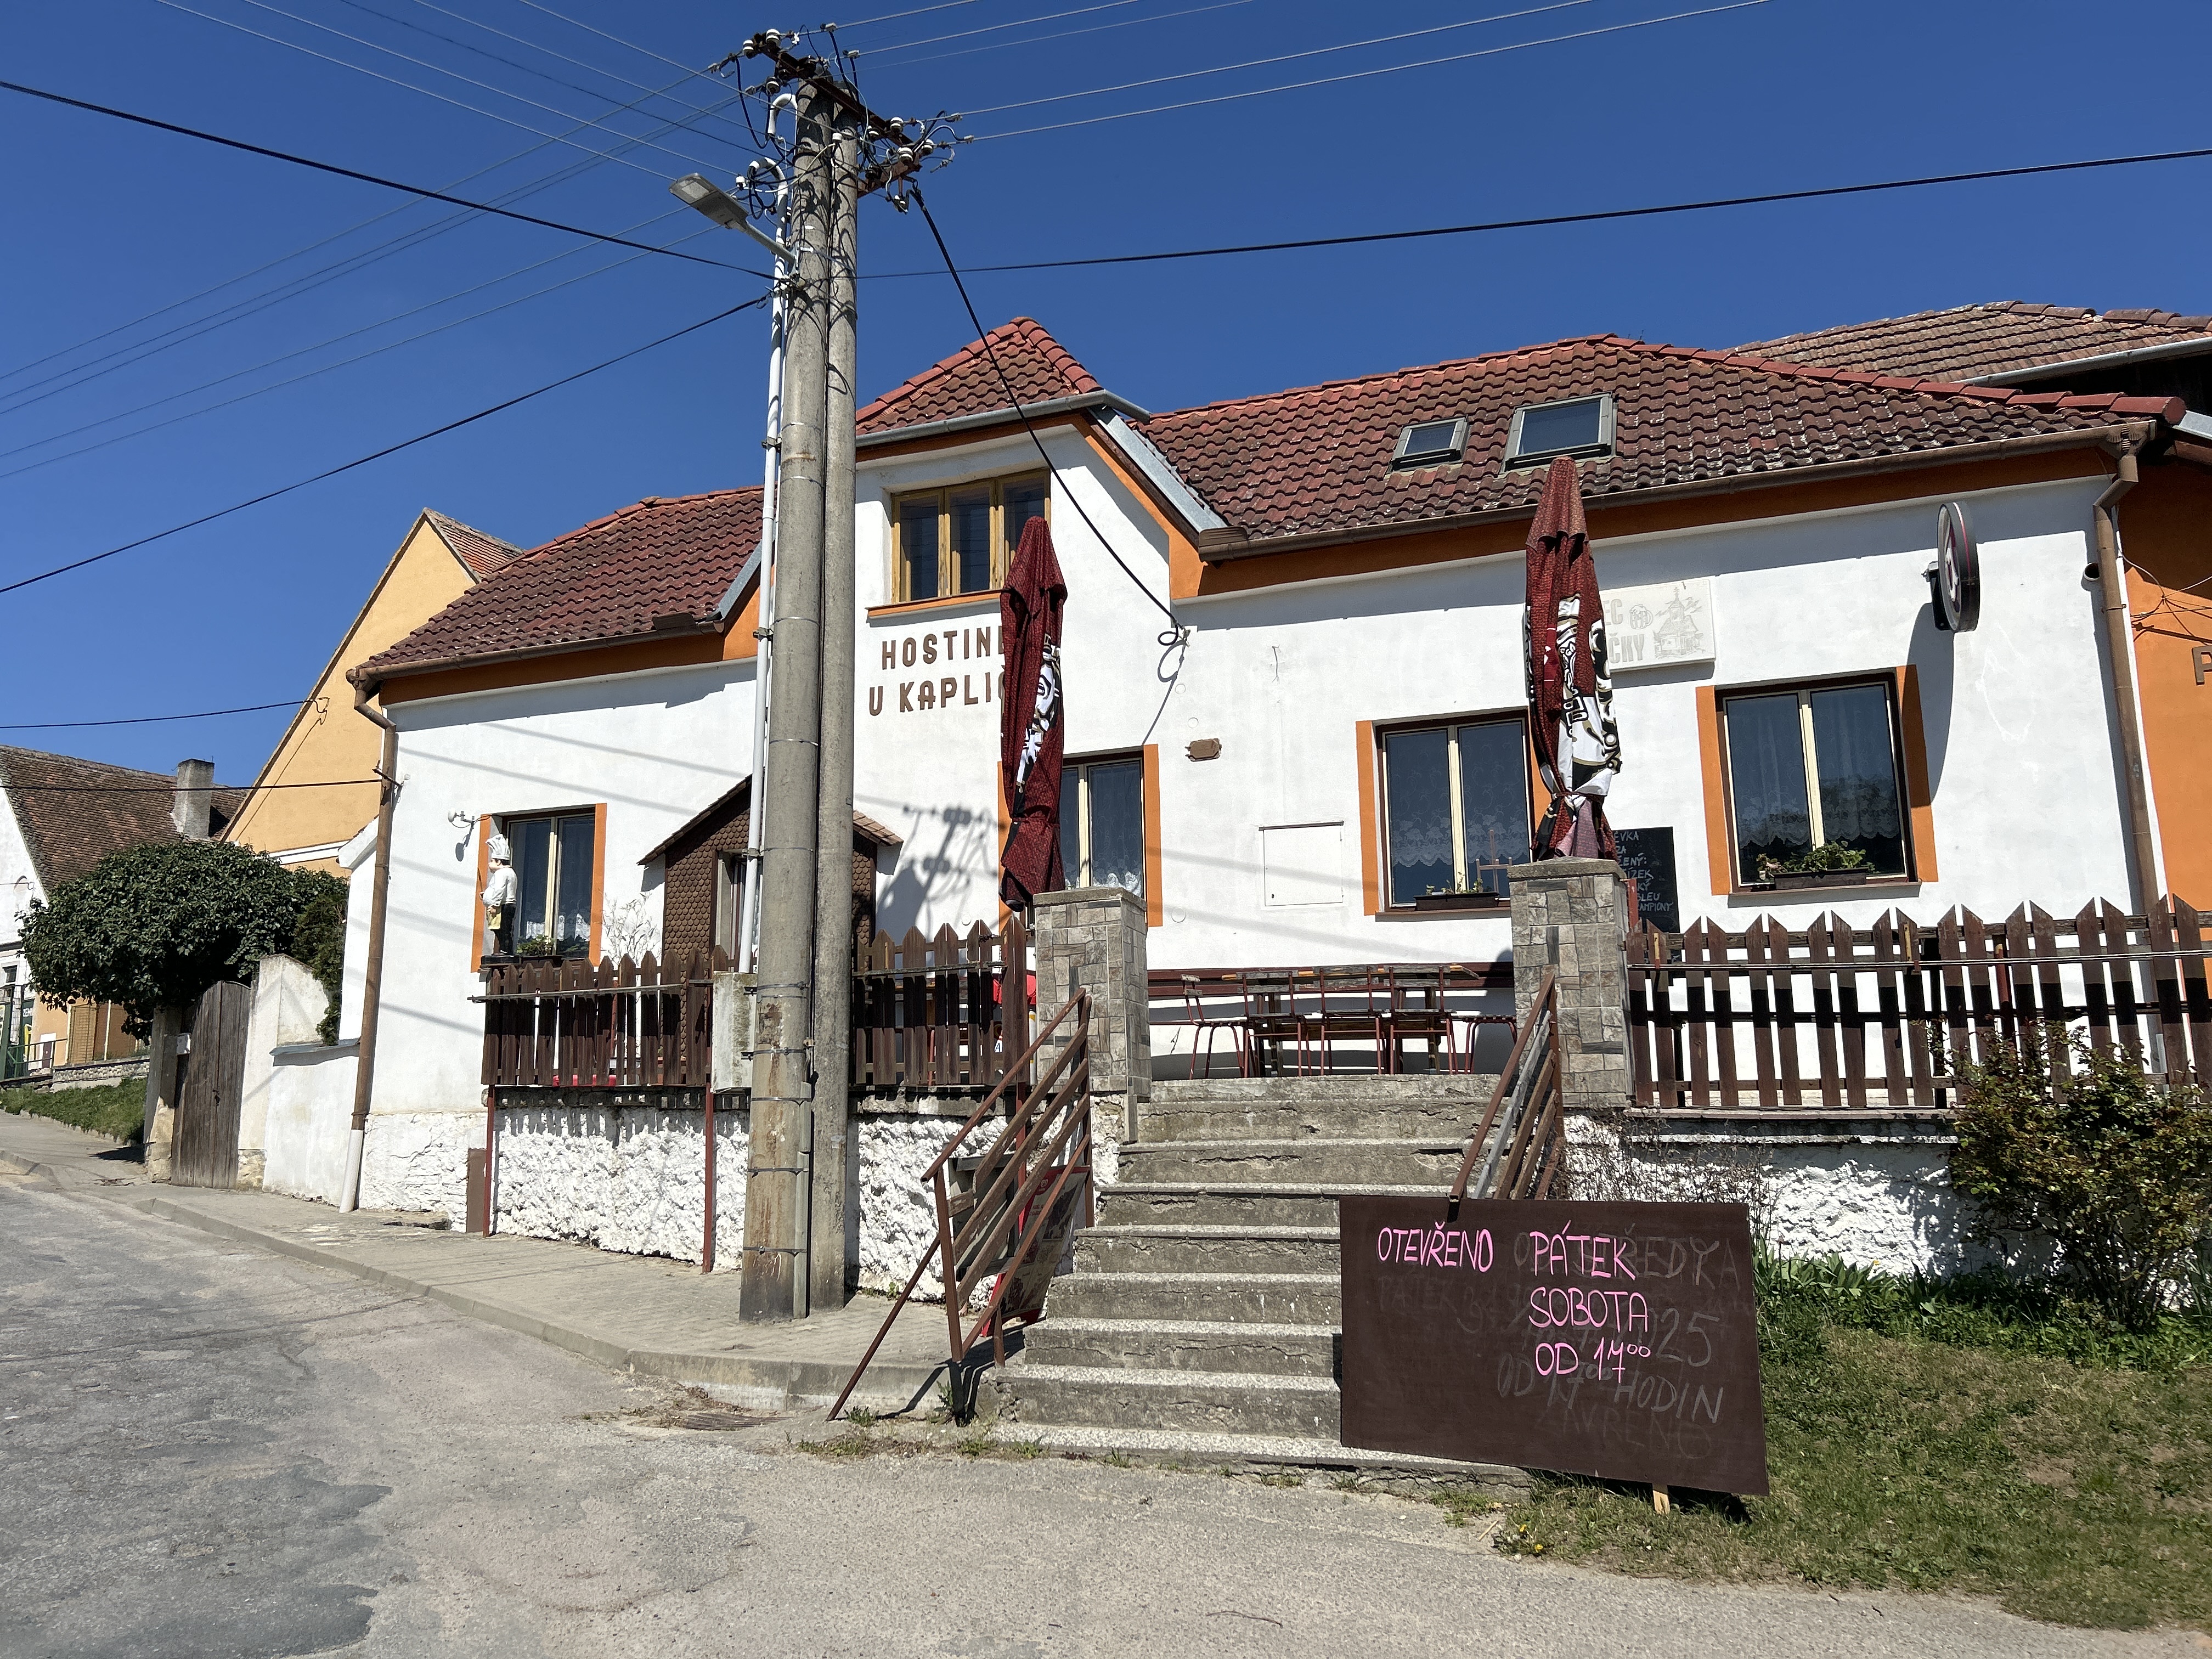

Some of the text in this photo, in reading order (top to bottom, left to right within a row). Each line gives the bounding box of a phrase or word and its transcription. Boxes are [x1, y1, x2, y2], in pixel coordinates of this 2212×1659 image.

[1609, 632, 1645, 664] ČKY
[869, 686, 883, 716] U
[1623, 867, 1654, 879] ÍZEK
[1638, 902, 1674, 912] AMPIONY
[1377, 1220, 1635, 1280] OTEVŘENO PÁTEK
[1528, 1286, 1648, 1333] SOBOTA
[1536, 1342, 1579, 1376] OD
